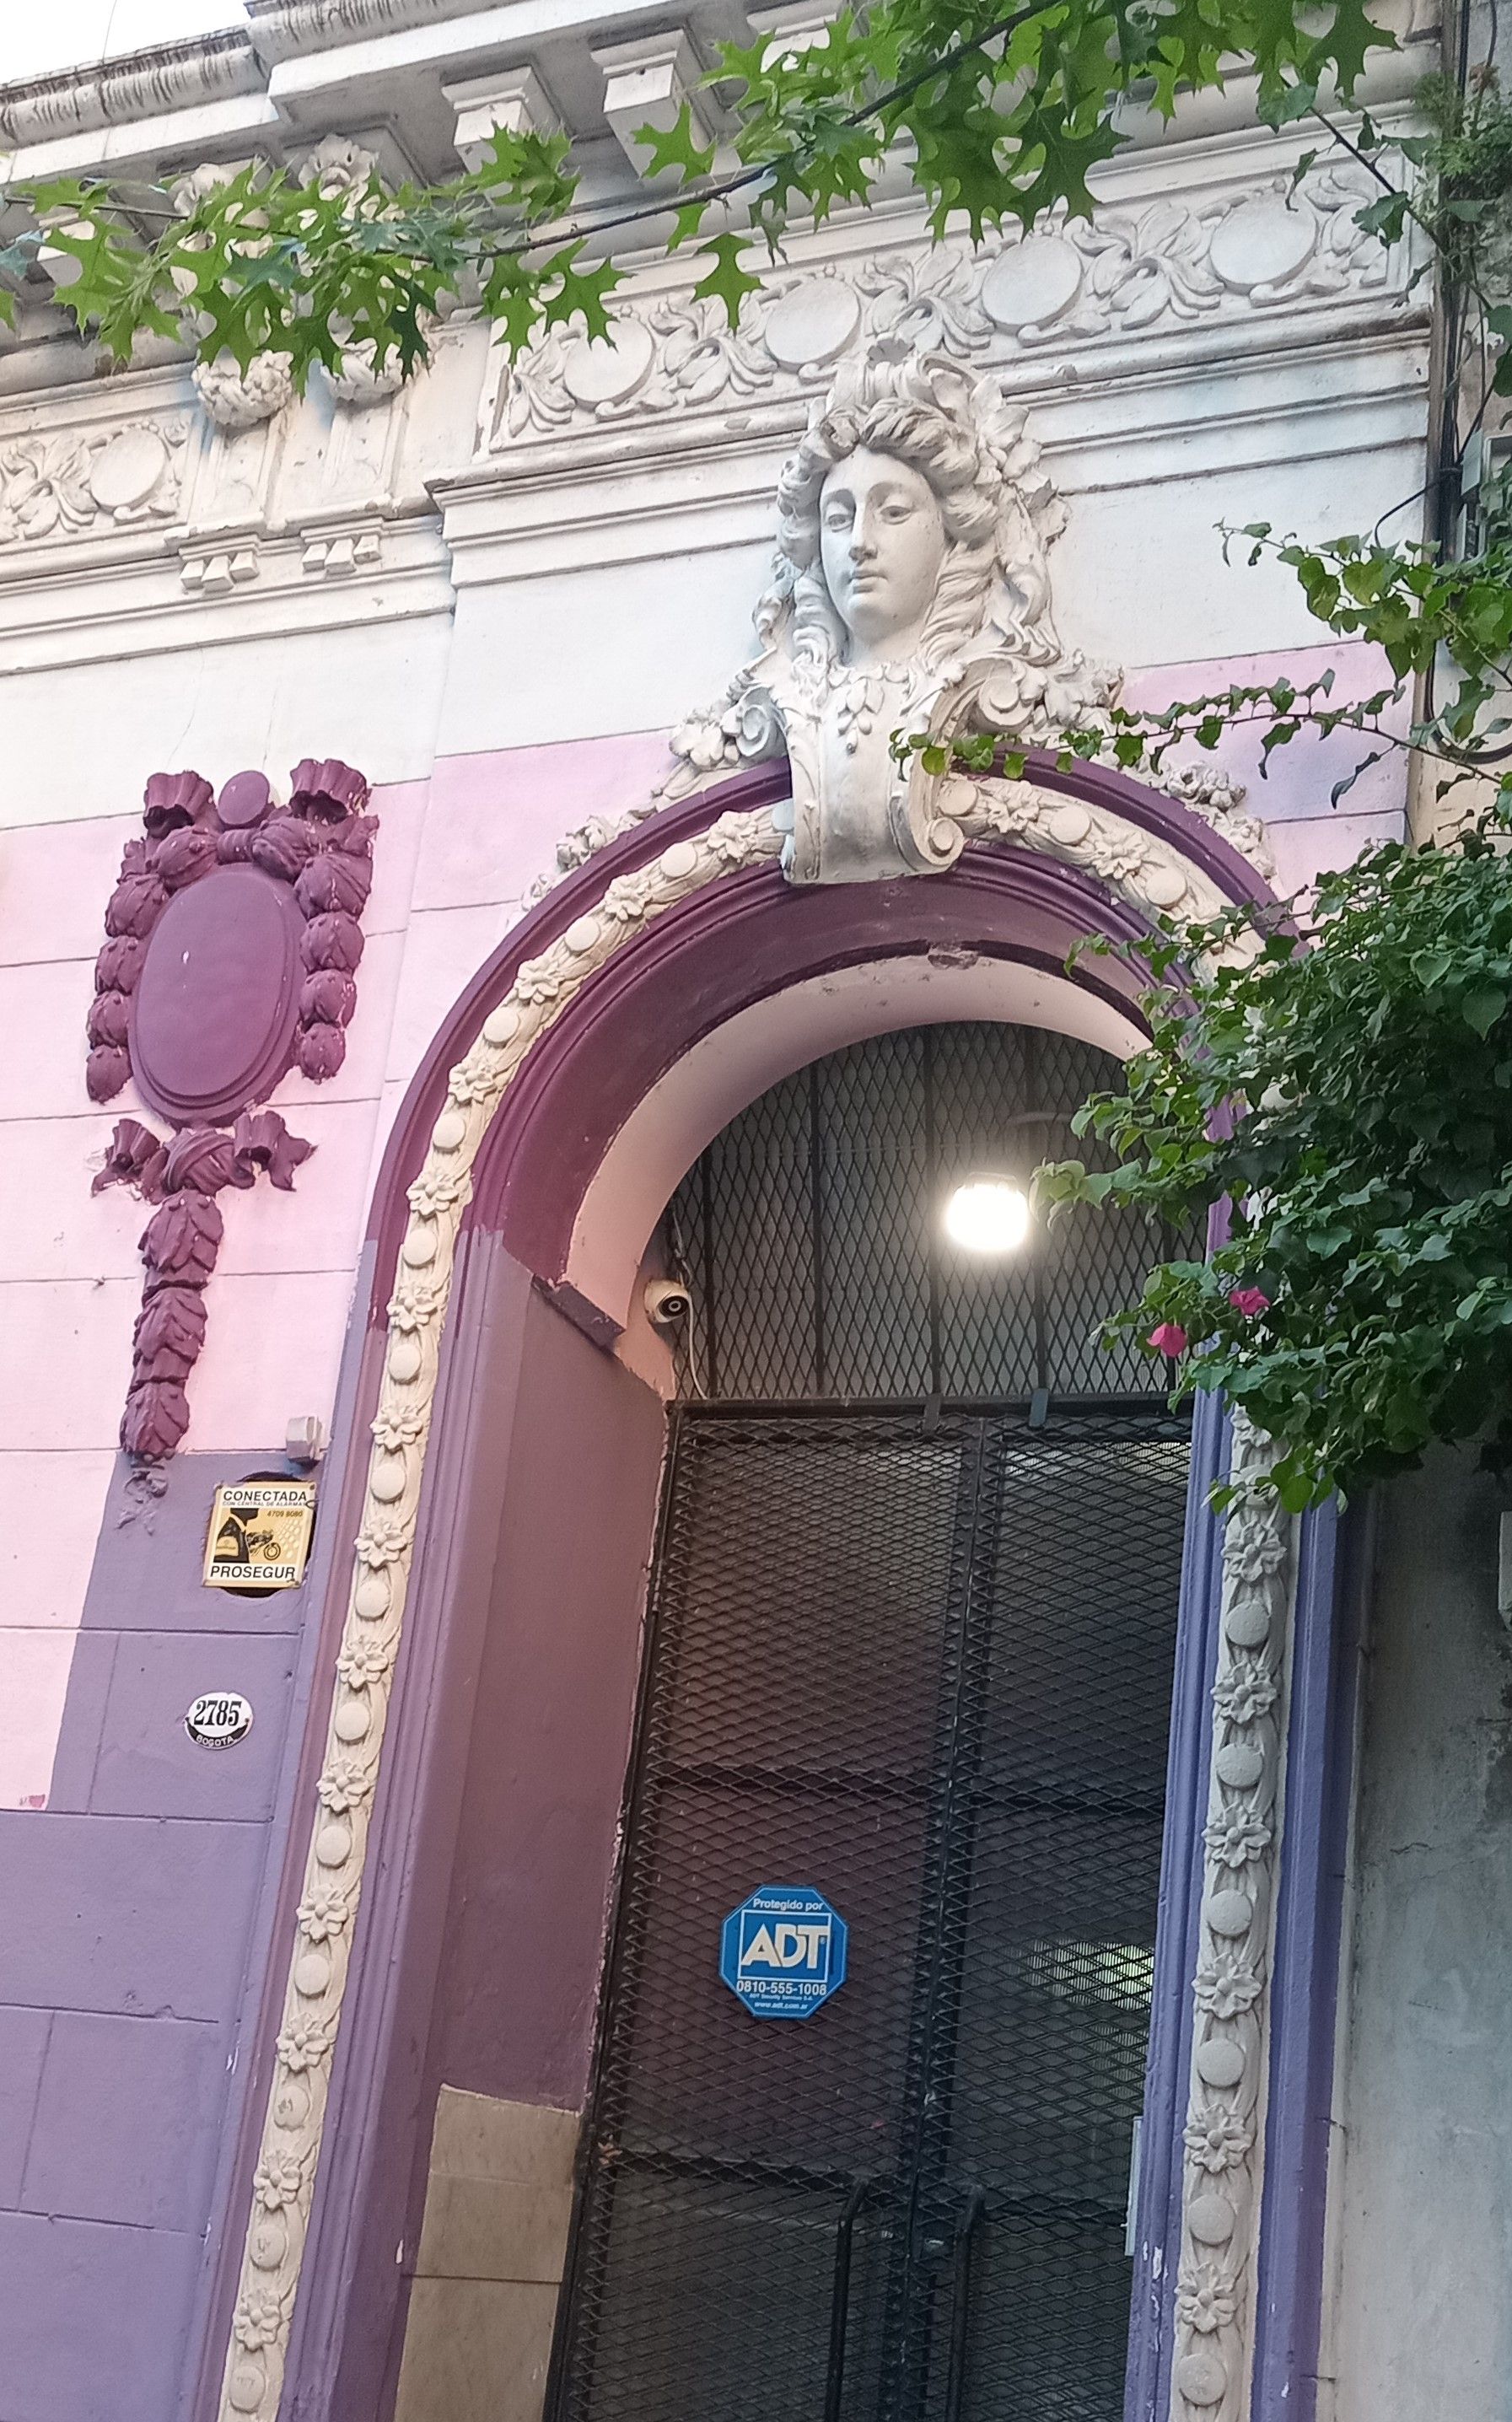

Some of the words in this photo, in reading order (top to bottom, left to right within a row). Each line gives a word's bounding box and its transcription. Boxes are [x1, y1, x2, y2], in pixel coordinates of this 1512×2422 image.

[223, 1490, 307, 1501] CONECTADA
[210, 1565, 295, 1579] PROSEGUR
[194, 1700, 242, 1726] 2785
[196, 1735, 234, 1747] BOGOTA
[753, 1897, 803, 1911] Protegido
[805, 1902, 824, 1912] por
[741, 1923, 831, 1969] ADT
[737, 1980, 827, 1996] 0810-555-1008
